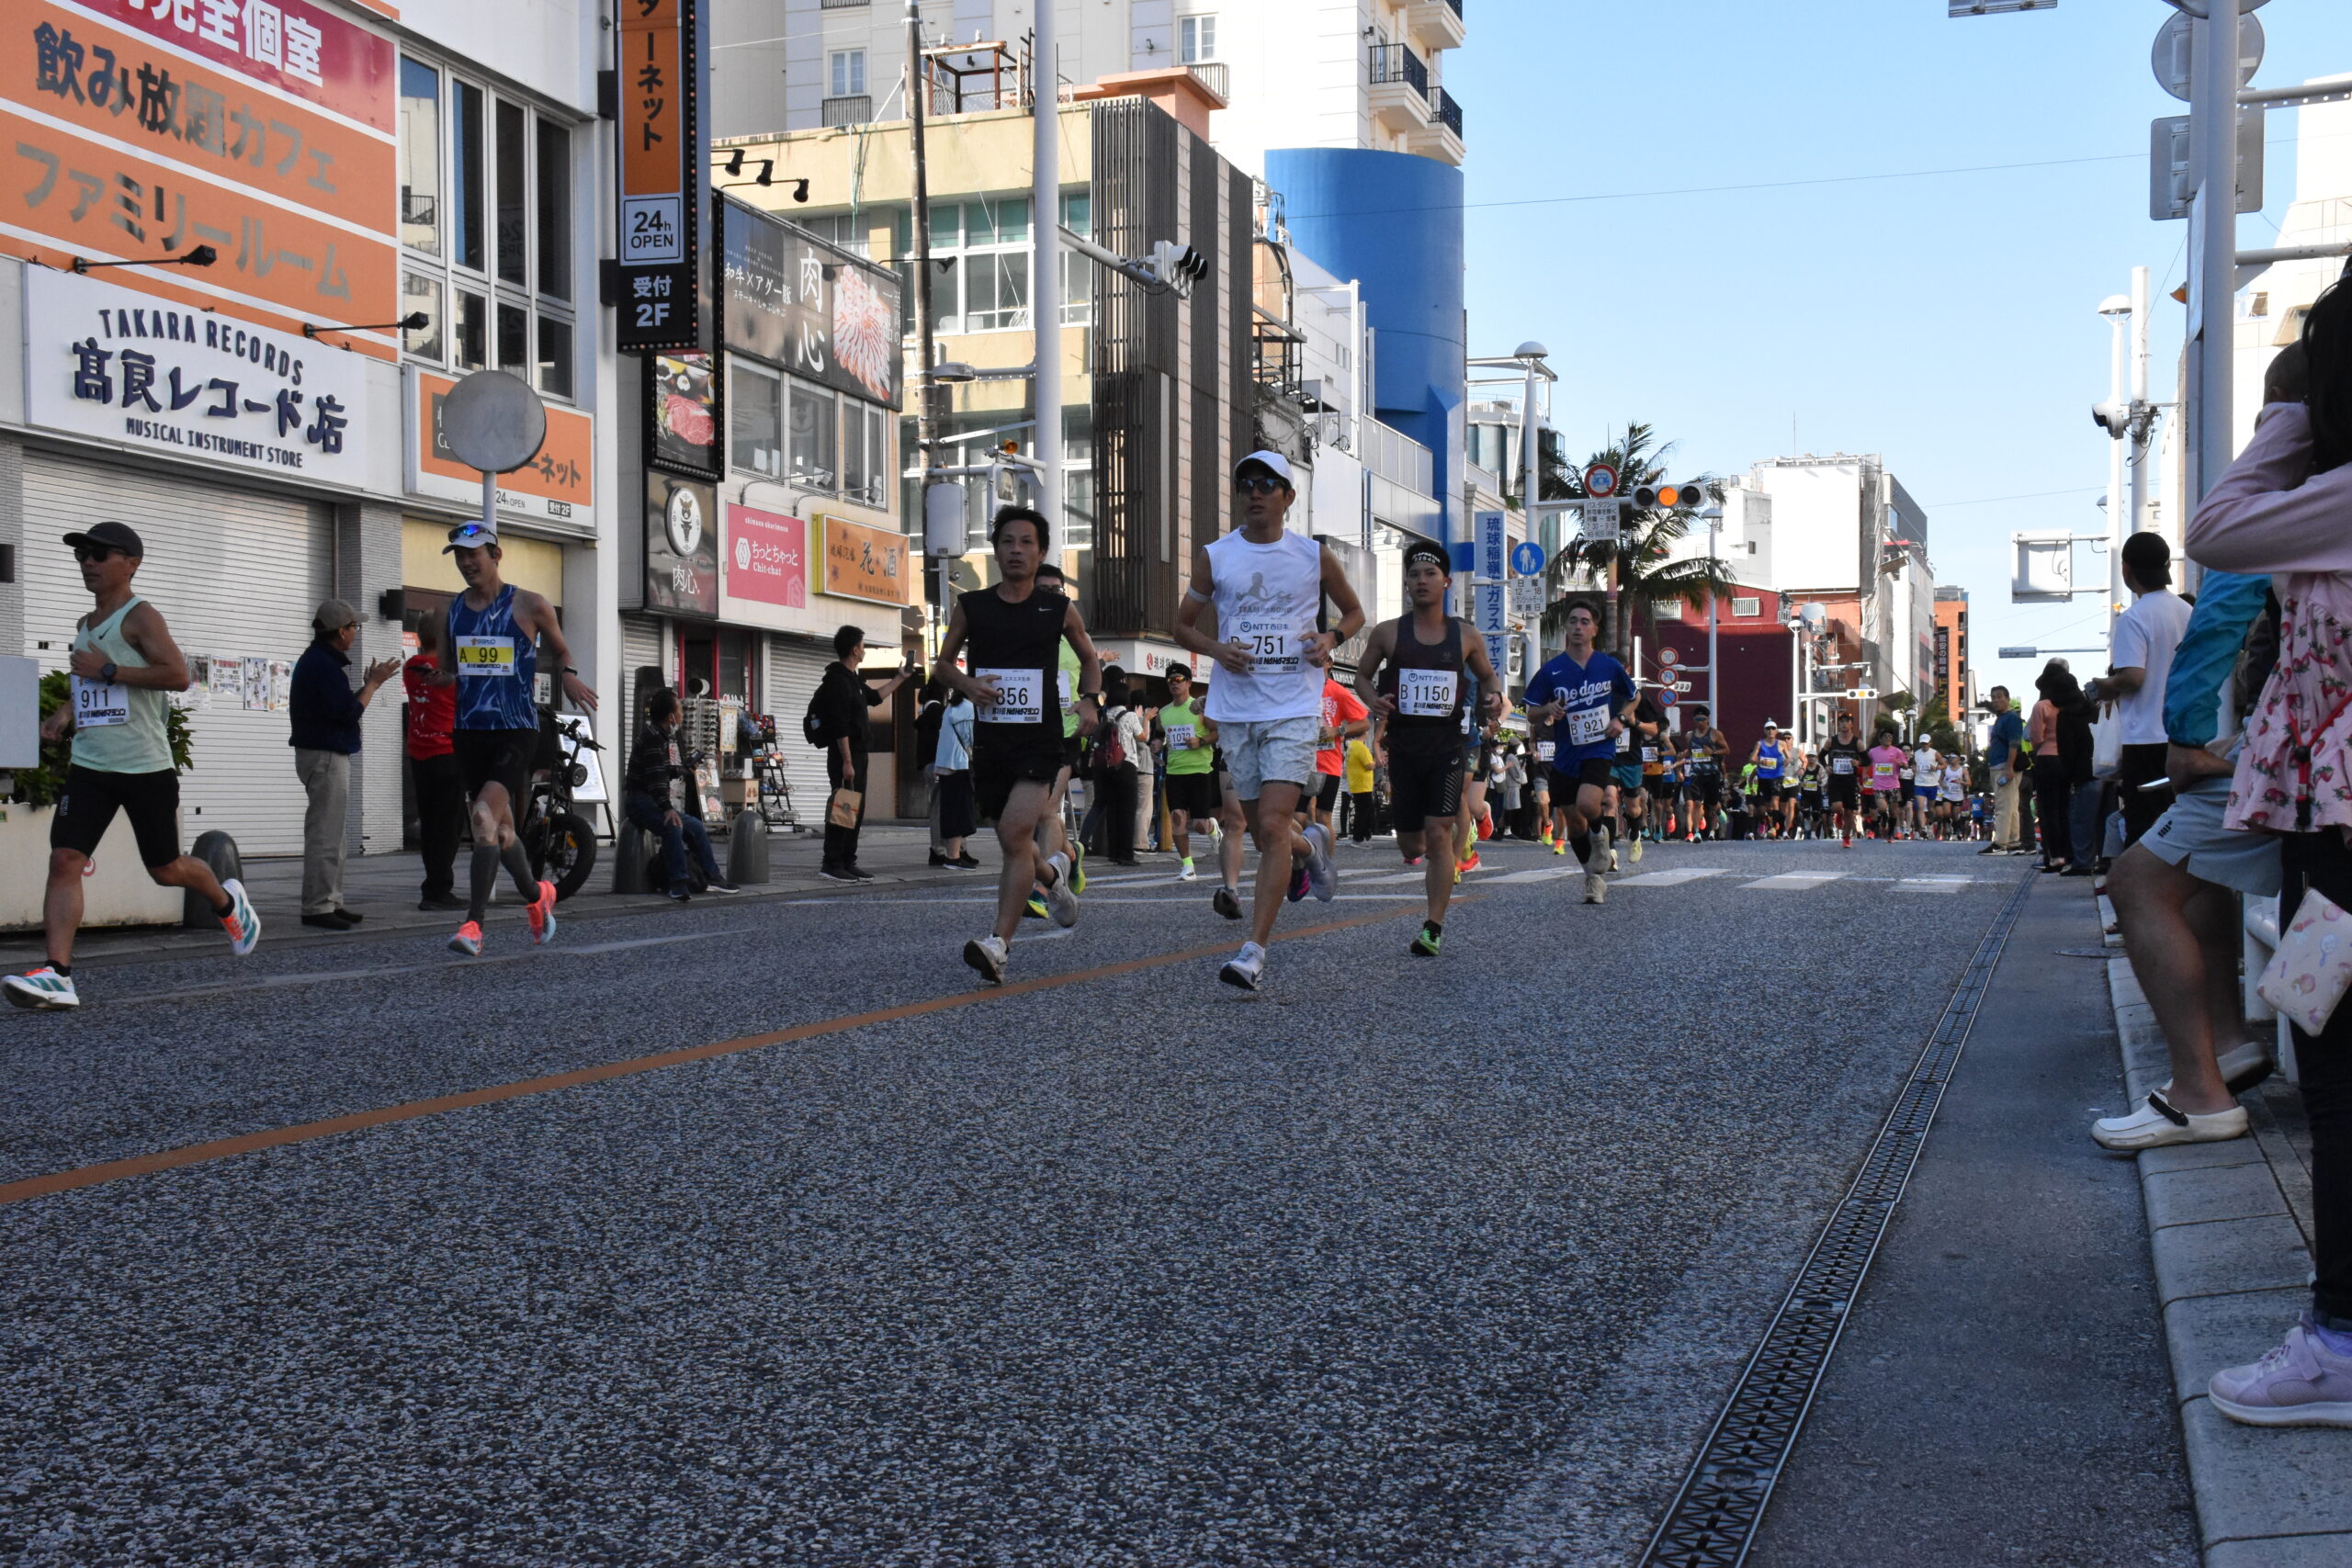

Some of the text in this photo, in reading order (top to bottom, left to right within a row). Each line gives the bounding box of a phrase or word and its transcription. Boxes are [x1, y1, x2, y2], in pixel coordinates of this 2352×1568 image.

[33, 21, 337, 195] 飲み放題カフェ
[16, 141, 351, 302] ファミリールーム
[630, 234, 673, 249] OPEN
[632, 275, 672, 299] 受付
[636, 303, 671, 328] 2F
[98, 309, 304, 386] TAKARA RECORDS
[126, 417, 303, 468] MUSICAL INSTRUMENT STORE
[510, 498, 526, 508] OPEN
[752, 561, 782, 576] Chit-chat
[459, 647, 498, 663] A 99
[1252, 635, 1283, 655] 751
[81, 688, 108, 708] 911
[1400, 684, 1450, 702] B 1150
[1554, 680, 1611, 706] Dodgers
[1570, 724, 1578, 736] B
[1584, 718, 1604, 733] 921
